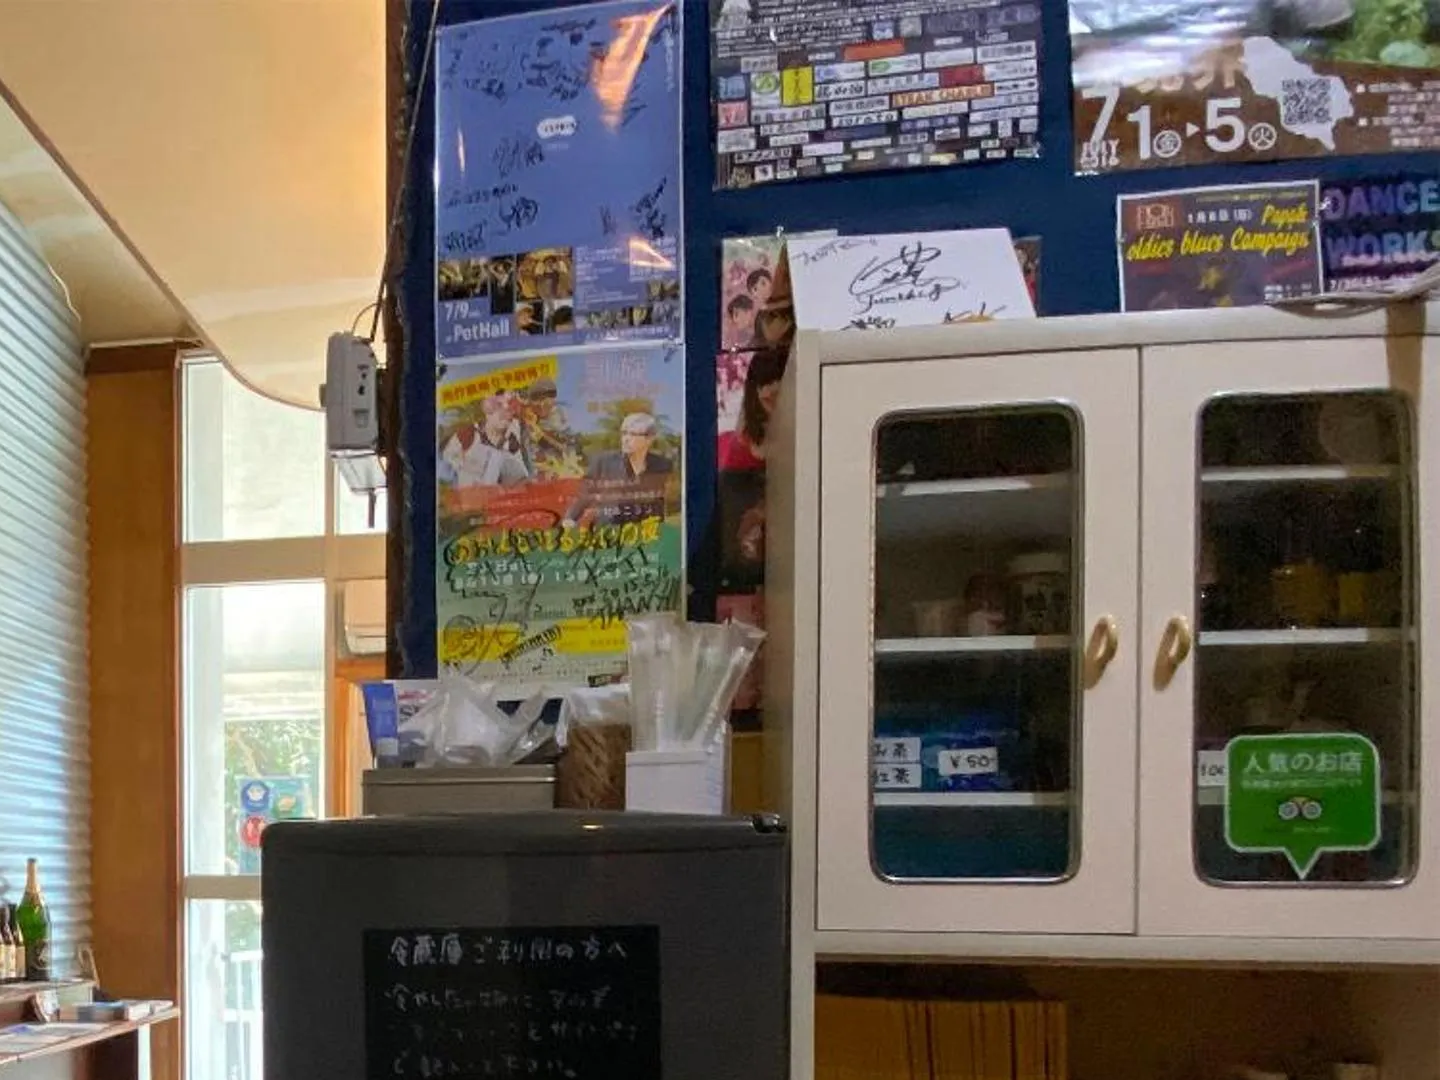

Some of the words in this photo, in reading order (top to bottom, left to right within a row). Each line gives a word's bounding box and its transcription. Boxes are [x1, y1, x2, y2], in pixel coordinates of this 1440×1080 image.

[1323, 179, 1440, 219] DANCE
[1244, 750, 1363, 774] 人気のお店
